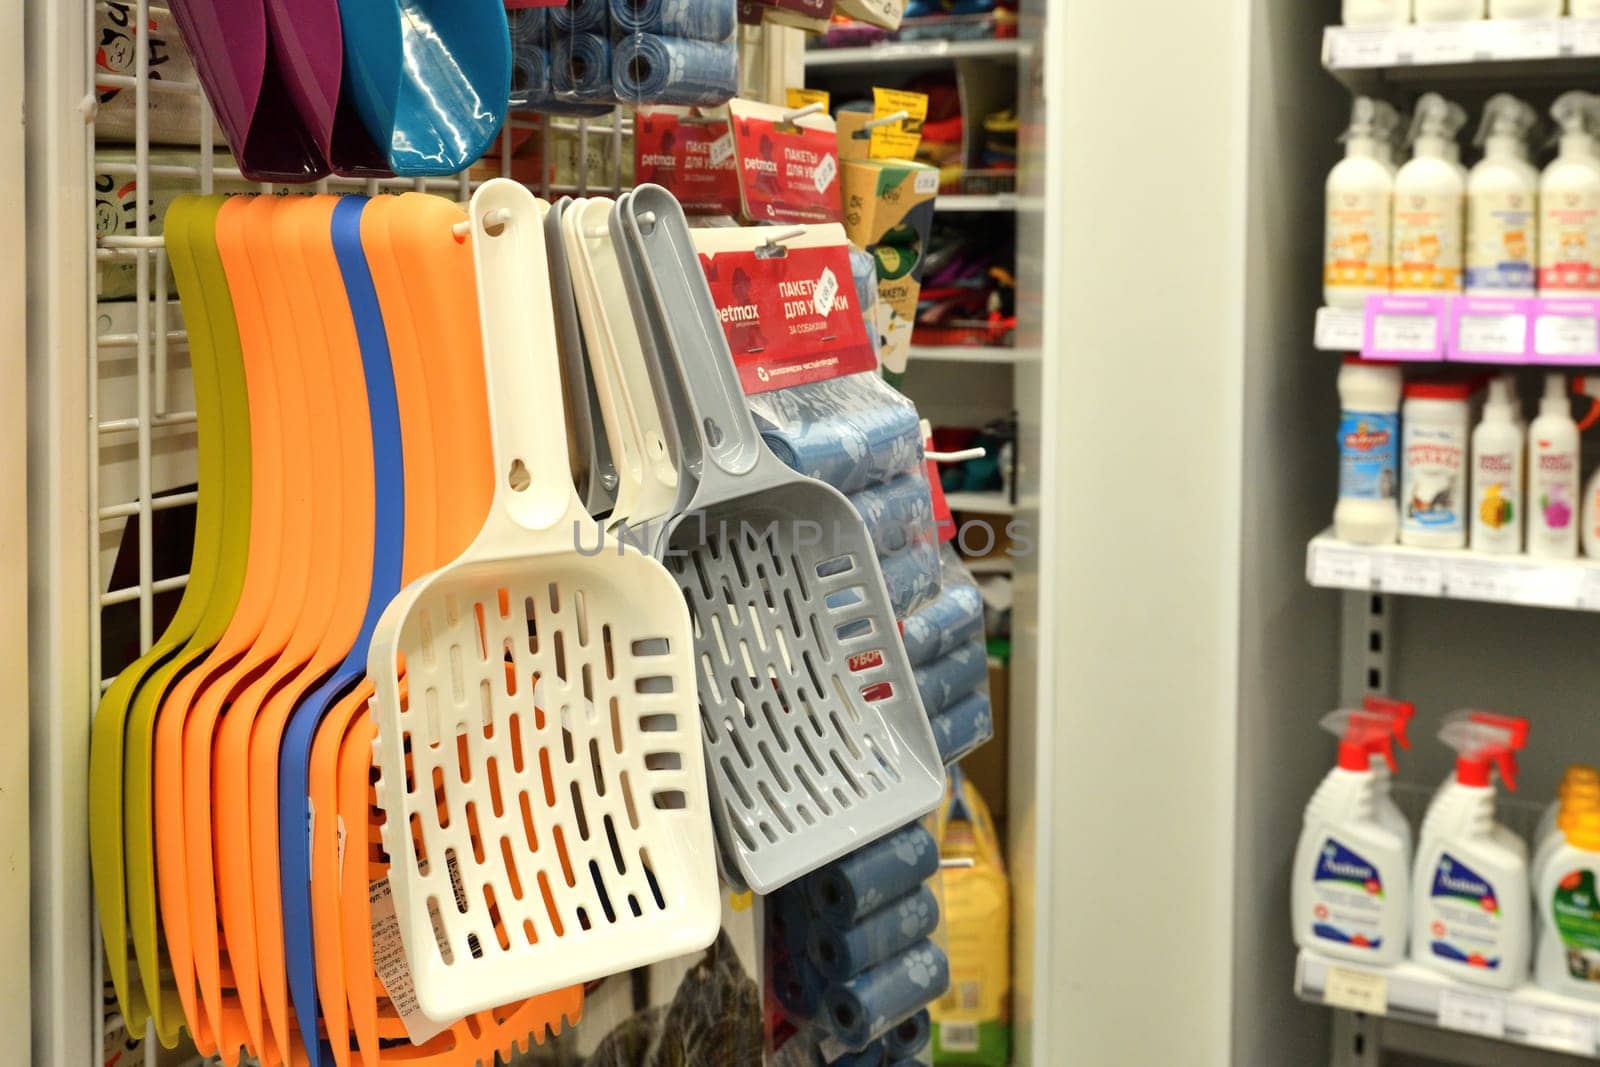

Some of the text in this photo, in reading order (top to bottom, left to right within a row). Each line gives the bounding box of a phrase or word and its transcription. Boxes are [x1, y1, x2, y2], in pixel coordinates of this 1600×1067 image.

[642, 154, 676, 168] petmax
[744, 157, 777, 172] petmax
[784, 300, 807, 320] ДЛЯ
